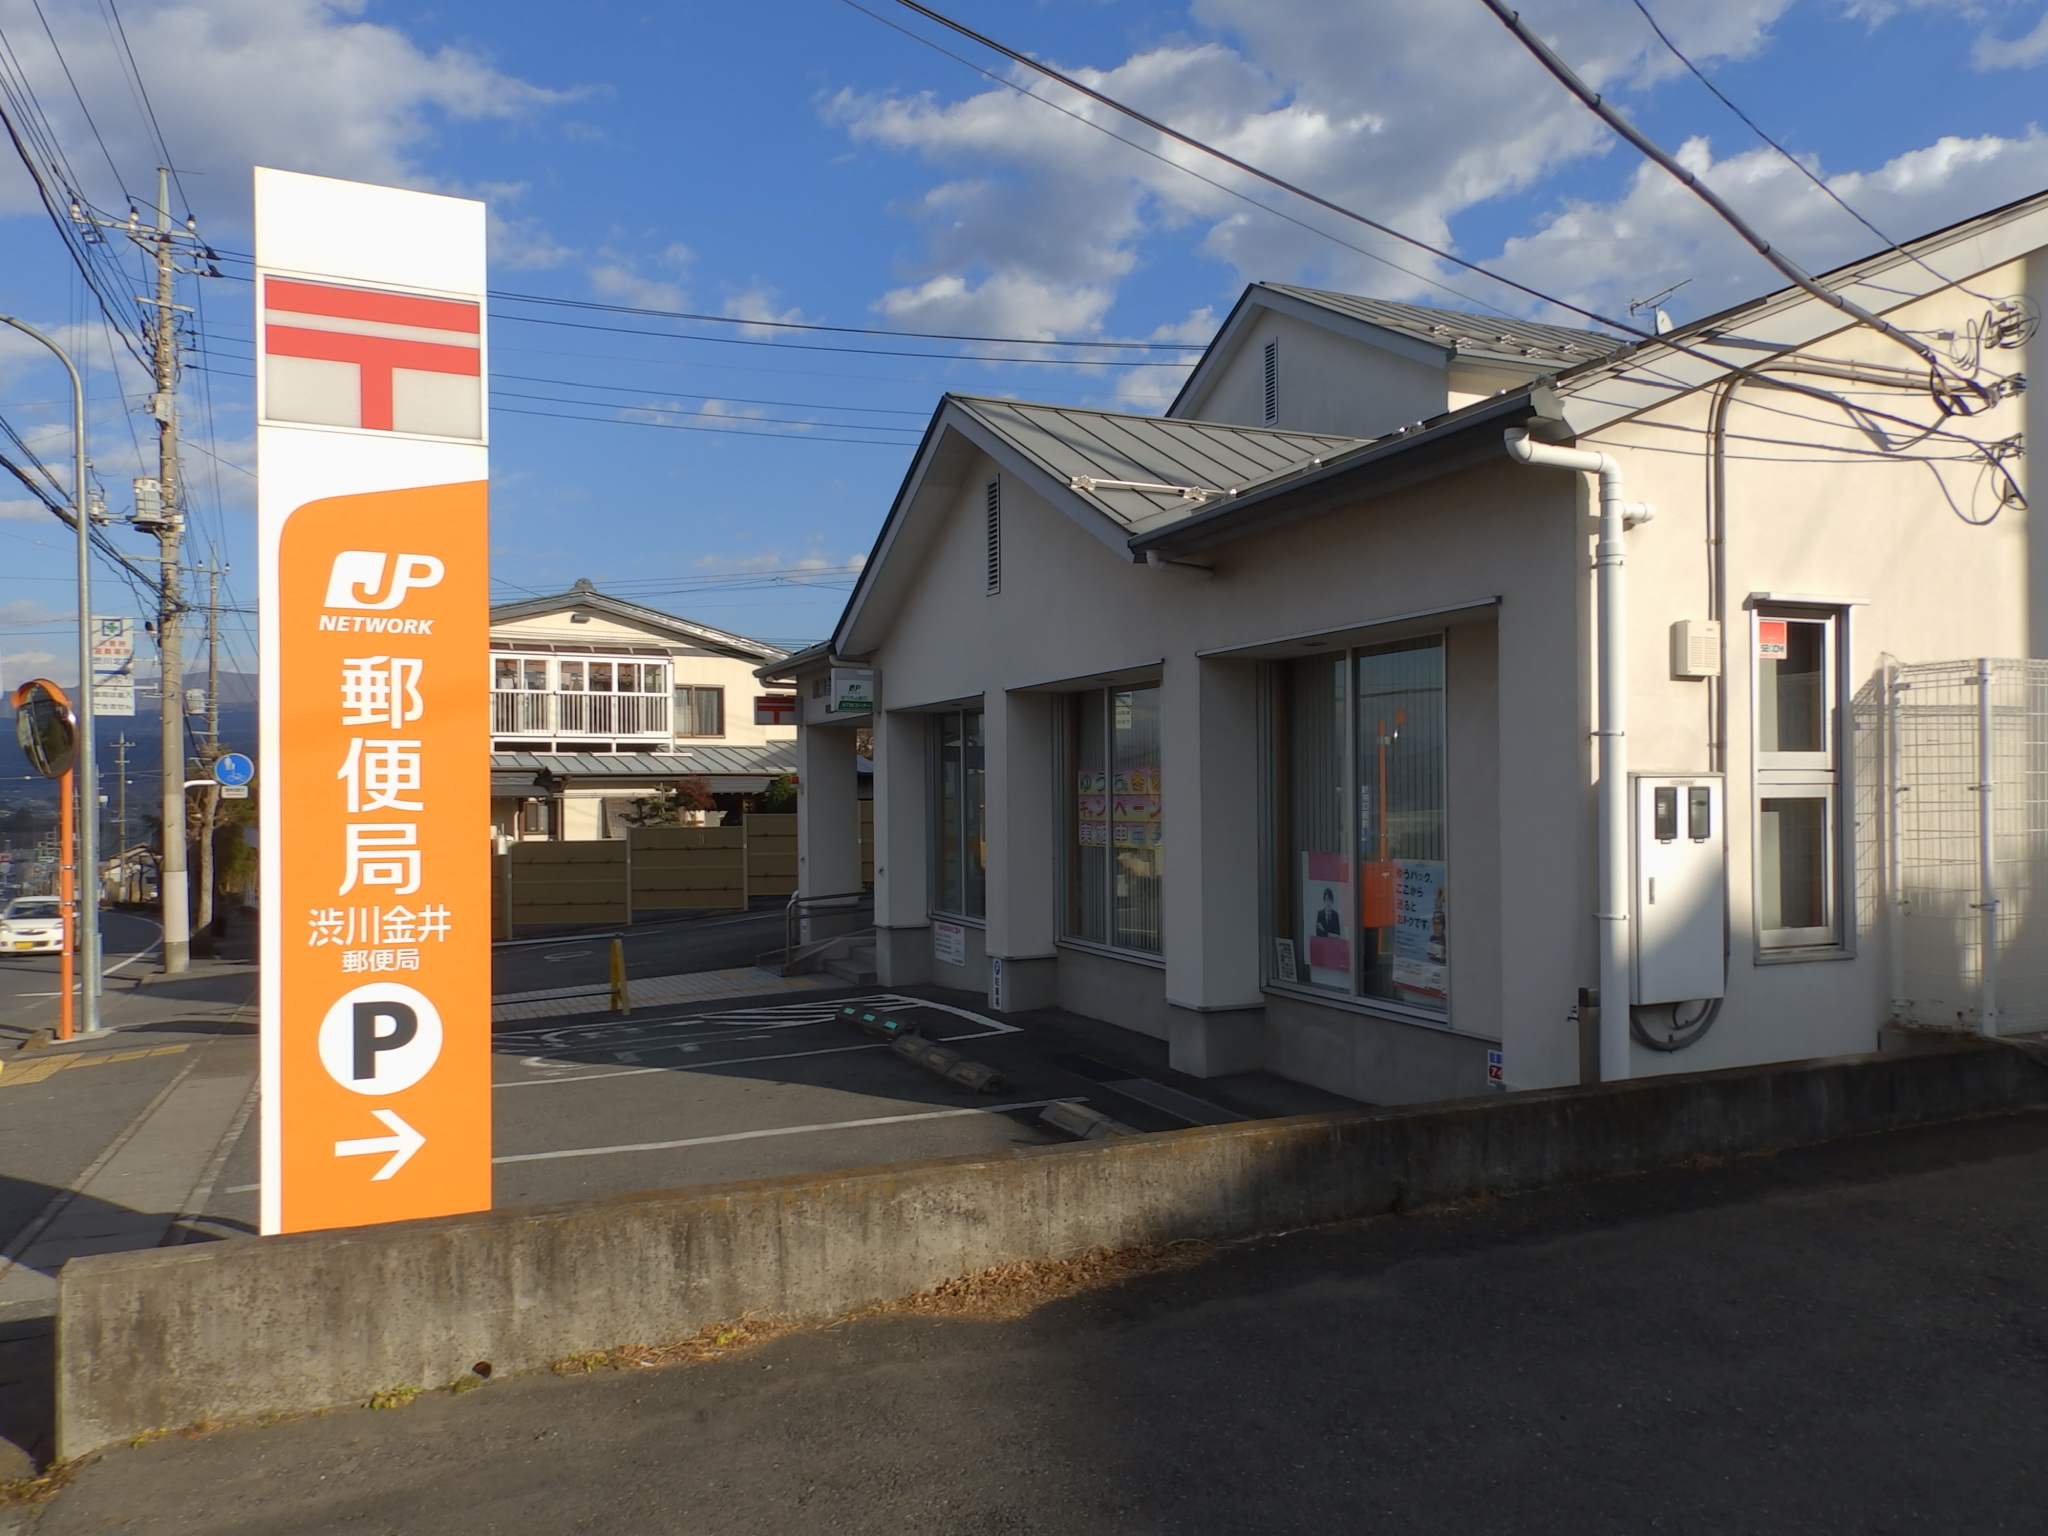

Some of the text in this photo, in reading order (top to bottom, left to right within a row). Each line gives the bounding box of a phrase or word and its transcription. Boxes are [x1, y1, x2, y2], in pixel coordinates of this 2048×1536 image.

[318, 613, 434, 636] NETWORK
[1760, 643, 1785, 653] SECOM
[337, 654, 426, 897] 郵便局
[1395, 883, 1424, 899] ここから
[1395, 899, 1418, 913] 送ると
[307, 903, 452, 948] 渋川金井
[340, 949, 420, 973] 郵便局
[351, 1000, 419, 1081] P
